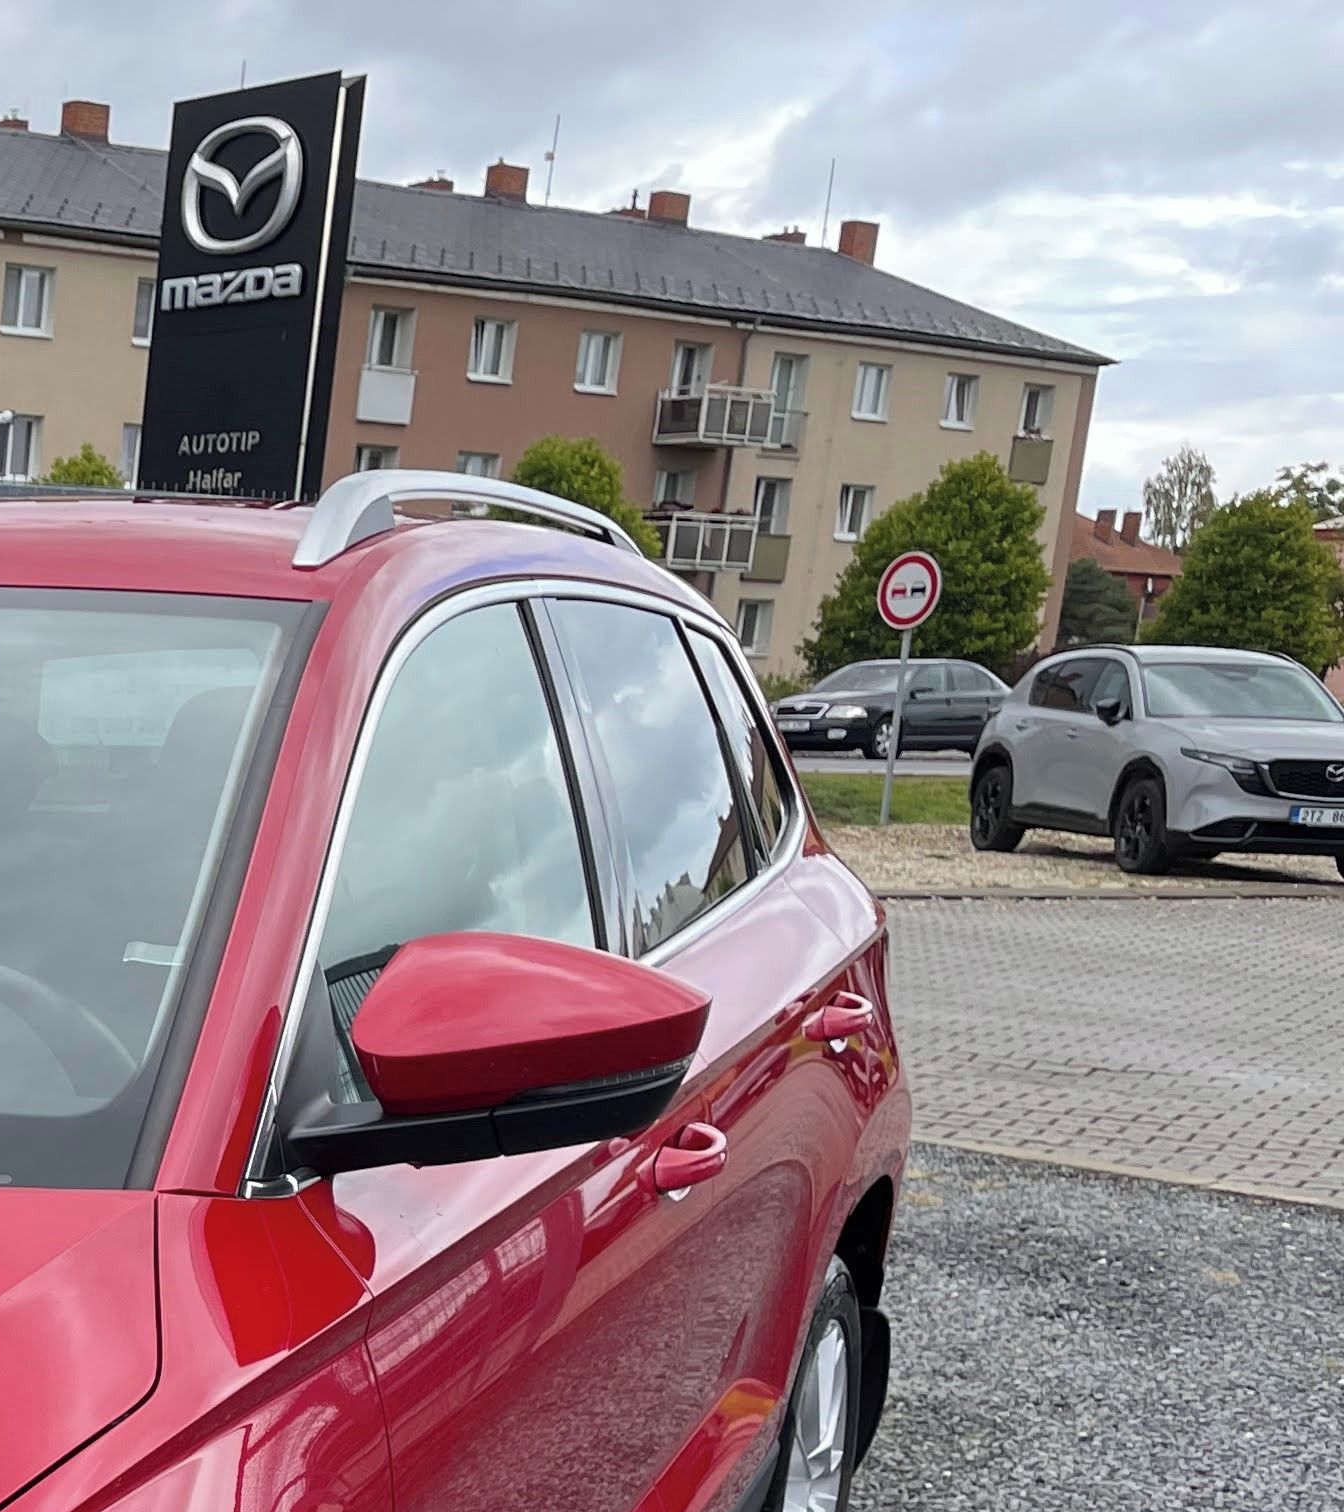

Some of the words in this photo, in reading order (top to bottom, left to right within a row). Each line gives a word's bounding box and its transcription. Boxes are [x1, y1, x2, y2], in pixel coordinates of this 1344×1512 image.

[160, 263, 302, 311] mazda
[177, 430, 261, 456] AUTOTIP
[187, 467, 242, 491] Halfar
